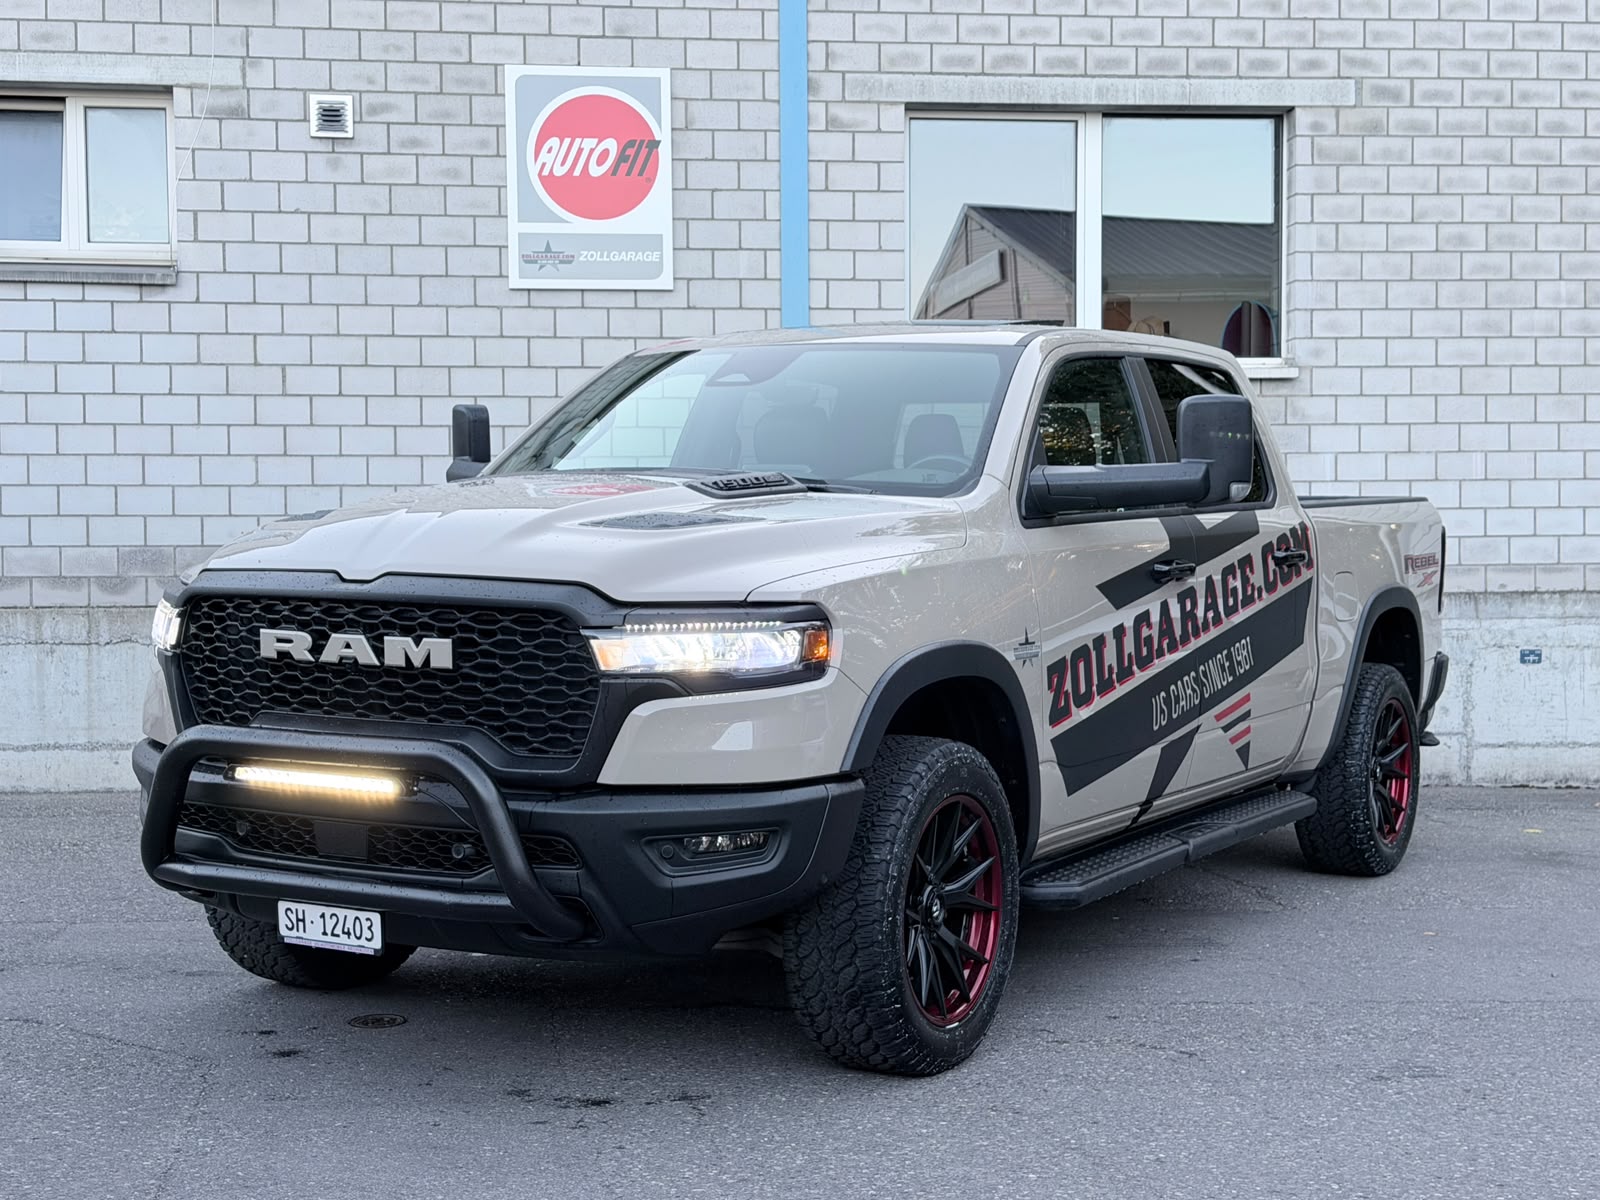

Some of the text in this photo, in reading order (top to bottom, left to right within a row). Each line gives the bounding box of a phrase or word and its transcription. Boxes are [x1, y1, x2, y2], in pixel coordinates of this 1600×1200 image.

[535, 137, 662, 177] AUTOFIT
[579, 250, 661, 262] ZOLLGARAGE
[712, 474, 764, 489] 1500
[1404, 552, 1439, 574] REBEL
[1047, 521, 1314, 729] ZOLLGARAGE.COM
[258, 627, 453, 670] RAM
[1151, 636, 1254, 731] US CARS SINCE 1981
